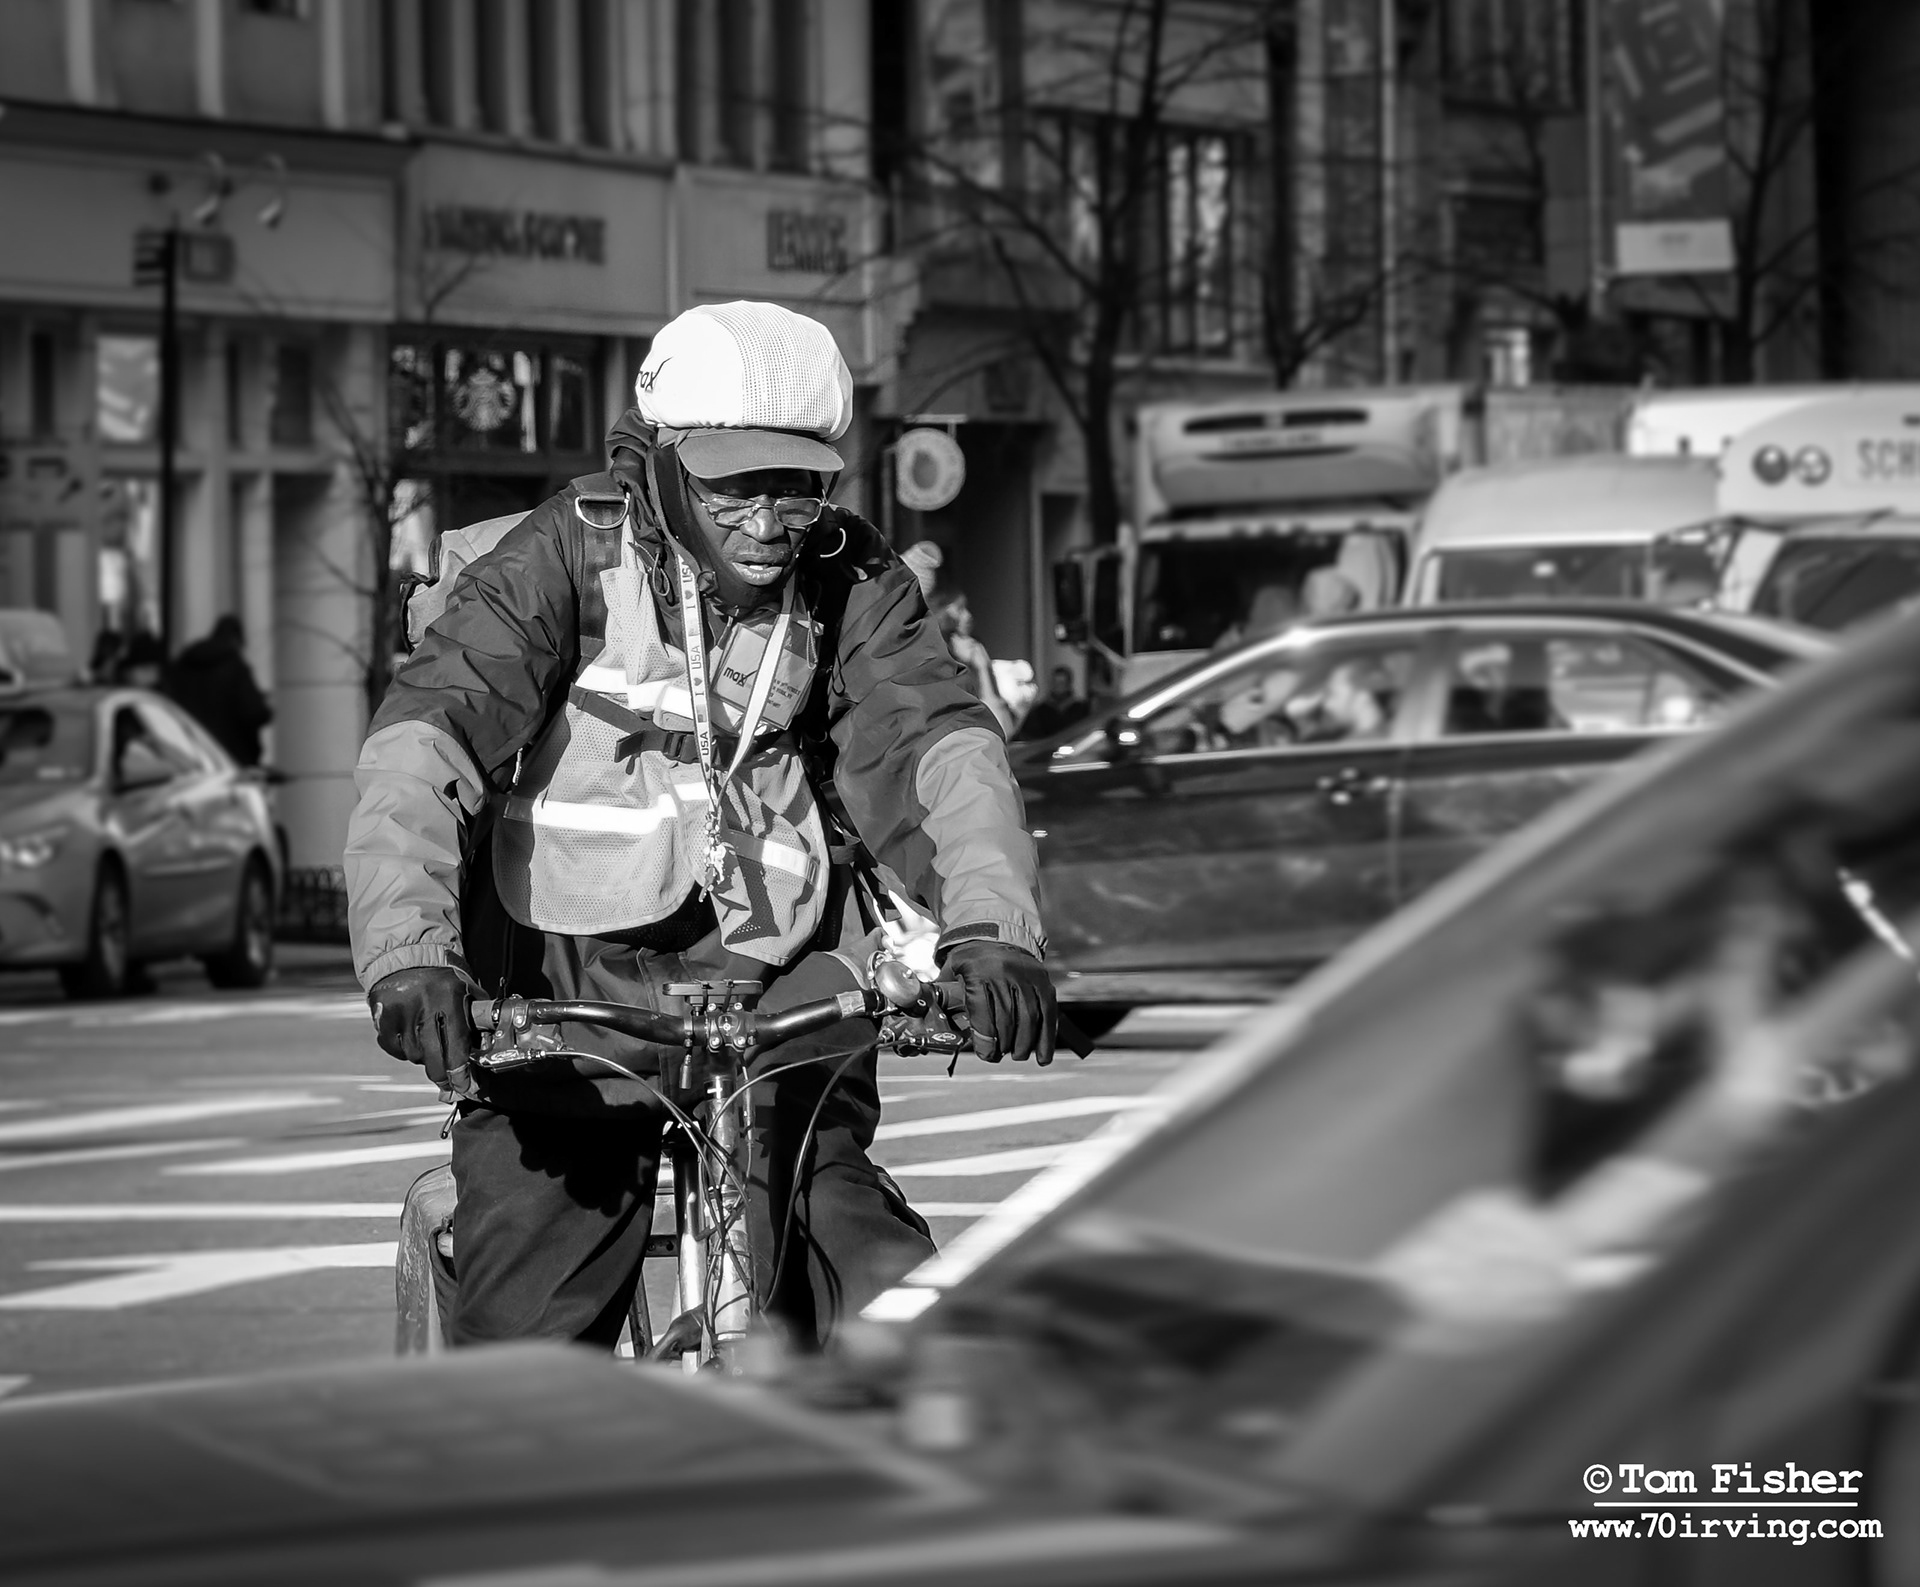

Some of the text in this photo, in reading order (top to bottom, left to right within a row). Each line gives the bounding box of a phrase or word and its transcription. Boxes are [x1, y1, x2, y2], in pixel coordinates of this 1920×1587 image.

[1857, 438, 1920, 479] SCH
[690, 645, 702, 670] USA
[699, 731, 710, 756] USA
